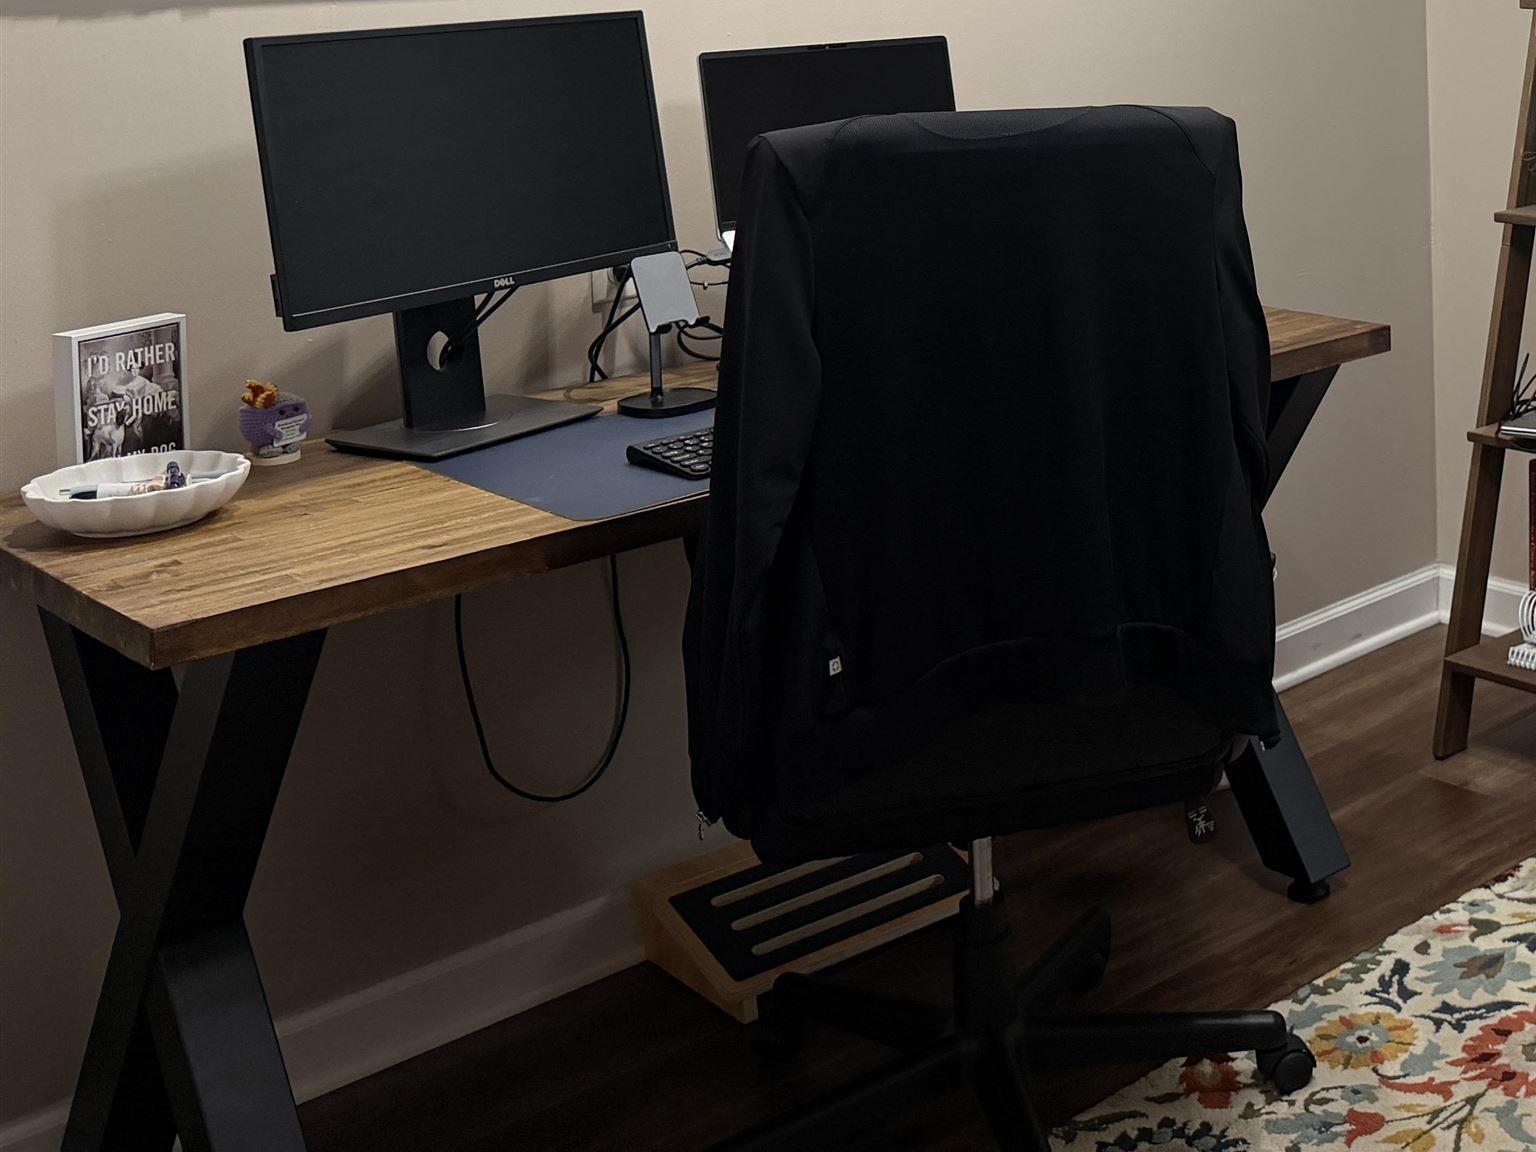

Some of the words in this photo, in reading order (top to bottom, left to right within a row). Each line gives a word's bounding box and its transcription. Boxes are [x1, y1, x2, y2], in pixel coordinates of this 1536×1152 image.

[494, 277, 515, 288] DELL
[87, 354, 110, 378] I'D
[115, 342, 176, 371] RATHER
[87, 401, 128, 428] STAY
[133, 390, 177, 419] HOME
